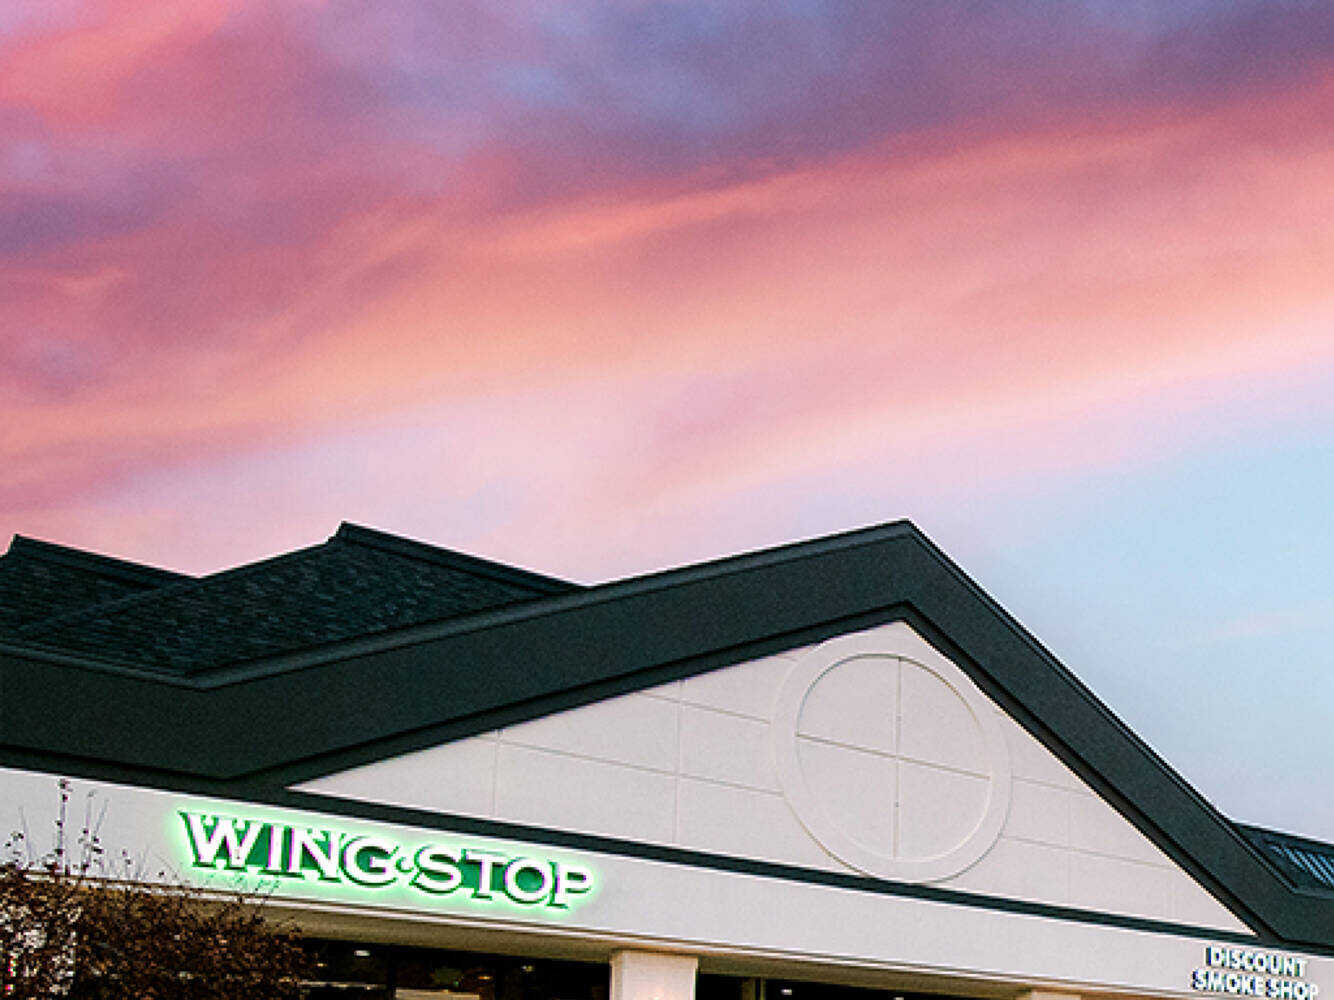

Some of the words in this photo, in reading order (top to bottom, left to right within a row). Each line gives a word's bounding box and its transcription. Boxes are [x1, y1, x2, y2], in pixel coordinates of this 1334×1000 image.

[1204, 946, 1308, 977] DISCOUNT
[1190, 968, 1264, 996] SMOKE
[1265, 977, 1319, 1000] SHOP
